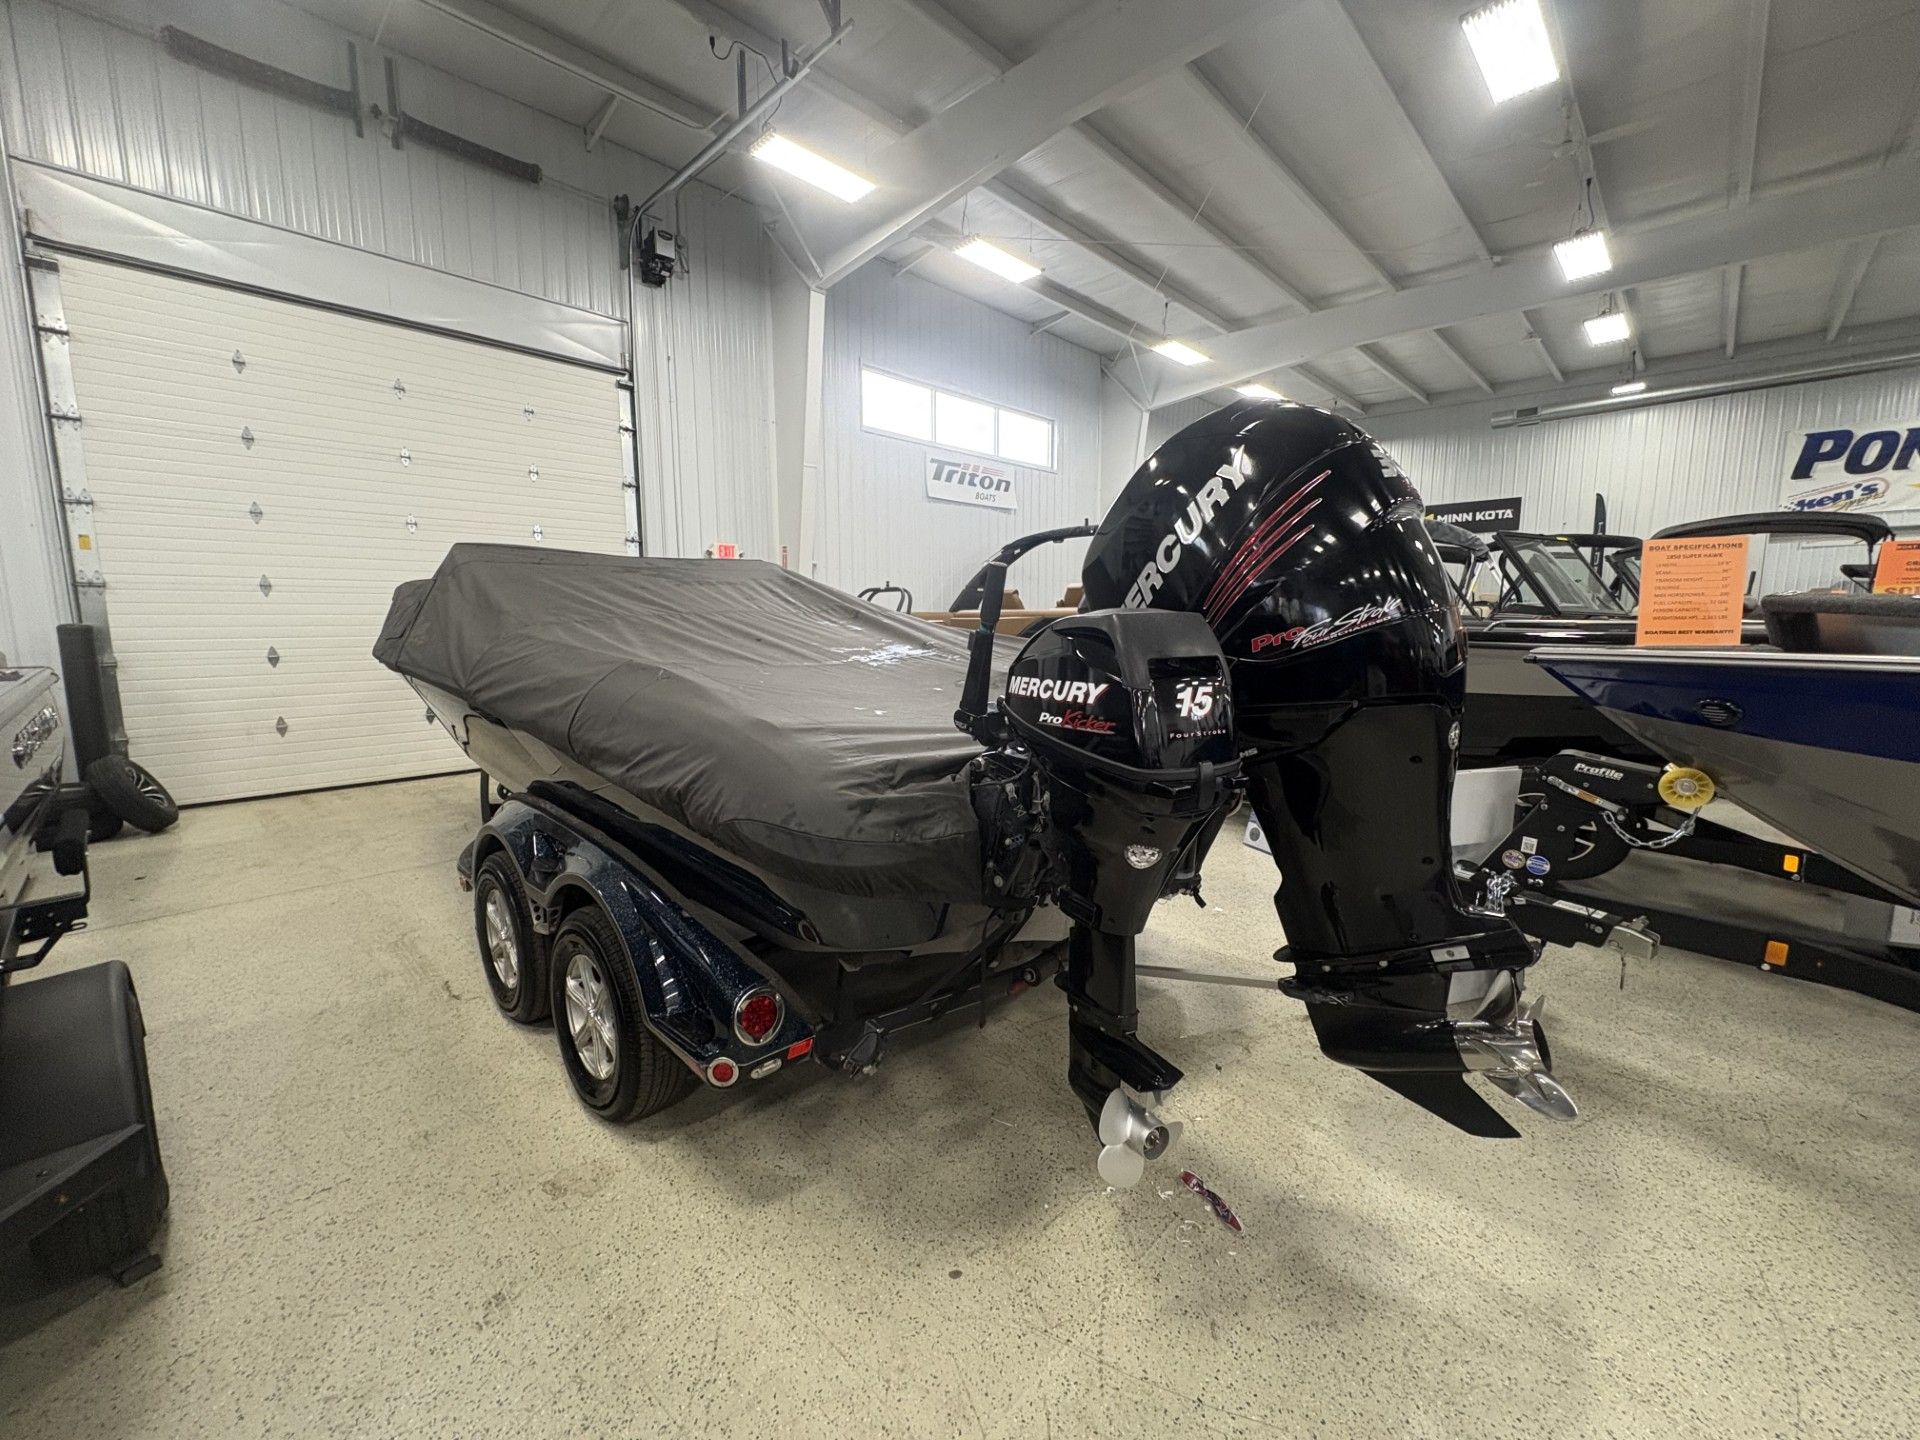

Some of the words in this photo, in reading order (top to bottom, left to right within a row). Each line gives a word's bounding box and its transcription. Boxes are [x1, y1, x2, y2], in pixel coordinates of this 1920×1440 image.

[930, 458, 1011, 492] Triton
[975, 492, 996, 502] BOATS
[1437, 512, 1473, 523] MINN
[1475, 508, 1514, 521] KOTA
[1121, 444, 1246, 608] ERCURY
[718, 544, 735, 559] EXIT
[1674, 542, 1743, 551] SPECIFICATIONS
[1009, 676, 1109, 705] MERCURY
[1177, 686, 1213, 717] 15
[1573, 763, 1624, 779] Profile
